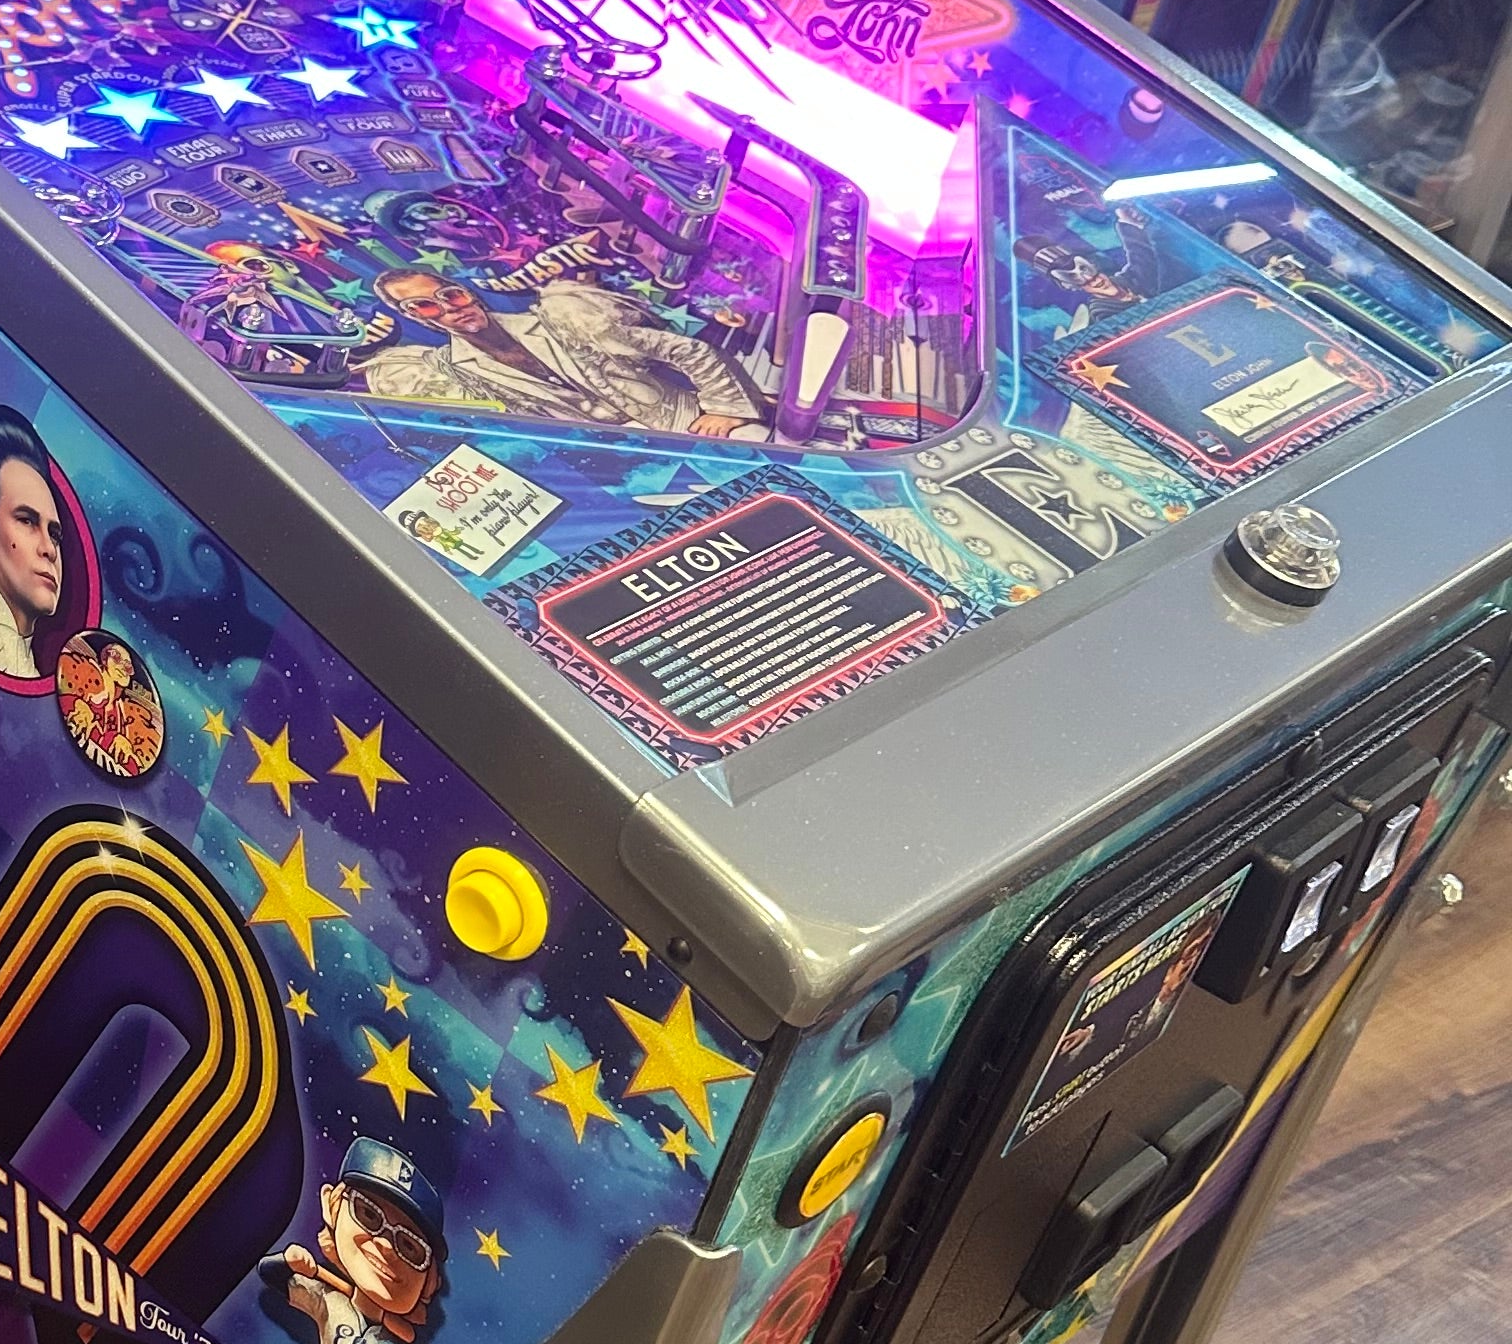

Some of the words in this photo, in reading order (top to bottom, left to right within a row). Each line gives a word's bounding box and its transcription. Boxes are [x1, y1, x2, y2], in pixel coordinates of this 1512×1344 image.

[57, 80, 78, 108] SUPER
[75, 69, 161, 87] STARDOM
[257, 127, 306, 143] THREE
[345, 119, 395, 132] FOUR
[165, 136, 215, 156] FINAL
[178, 145, 228, 165] TOUR
[108, 171, 148, 189] TWO
[470, 241, 615, 292] FANTASTIC
[1164, 323, 1238, 368] E
[1209, 369, 1250, 392] ELTON
[435, 474, 485, 514] SHOOT
[472, 463, 499, 483] ME
[487, 487, 513, 503] the
[620, 531, 751, 605] ELTON
[1079, 960, 1149, 1022] STARTS
